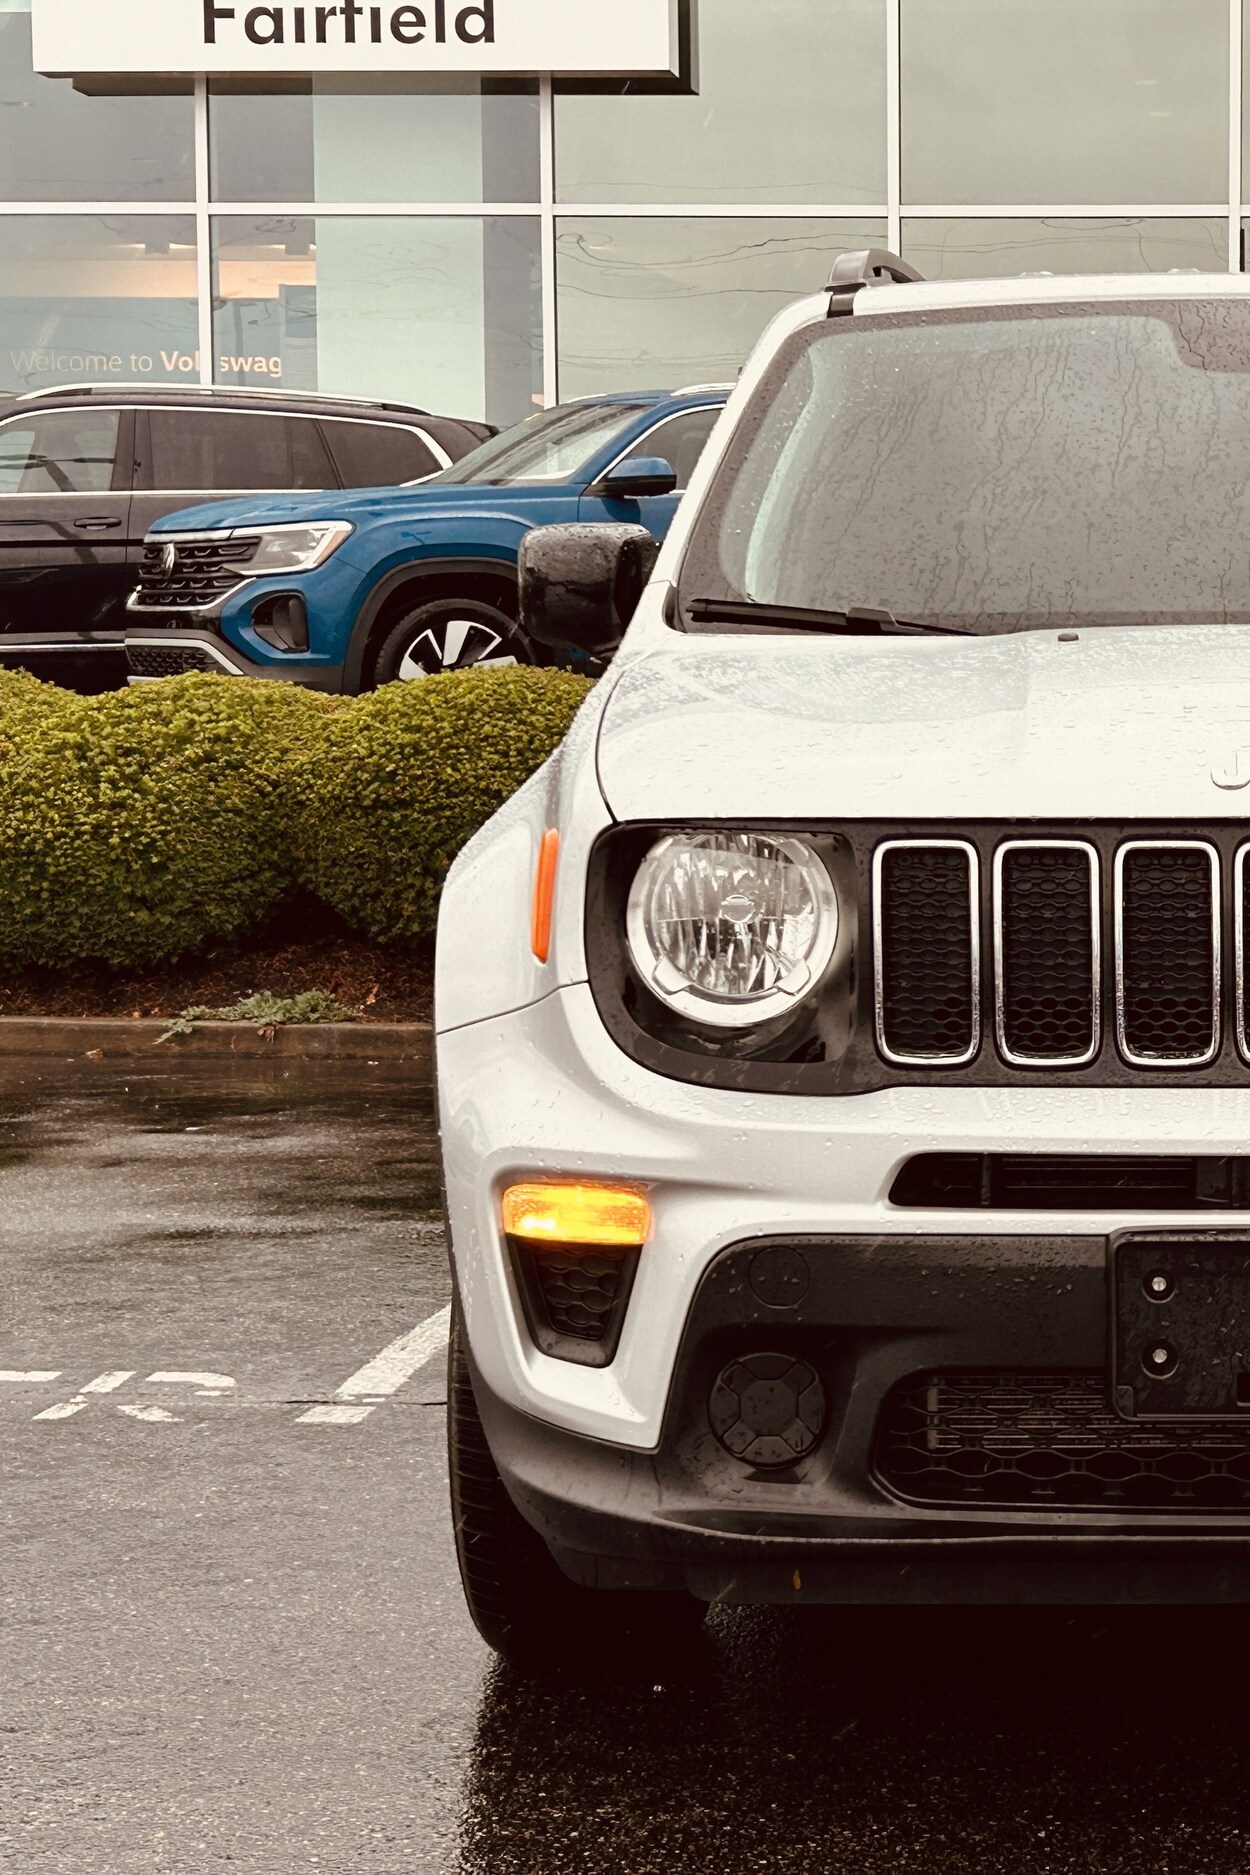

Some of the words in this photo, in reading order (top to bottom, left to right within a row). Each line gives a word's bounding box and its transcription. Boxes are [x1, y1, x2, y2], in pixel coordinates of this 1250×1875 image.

[203, 0, 495, 44] Fairfield
[10, 351, 122, 372] Welcome
[130, 353, 153, 372] to
[160, 350, 282, 377] Volswag
